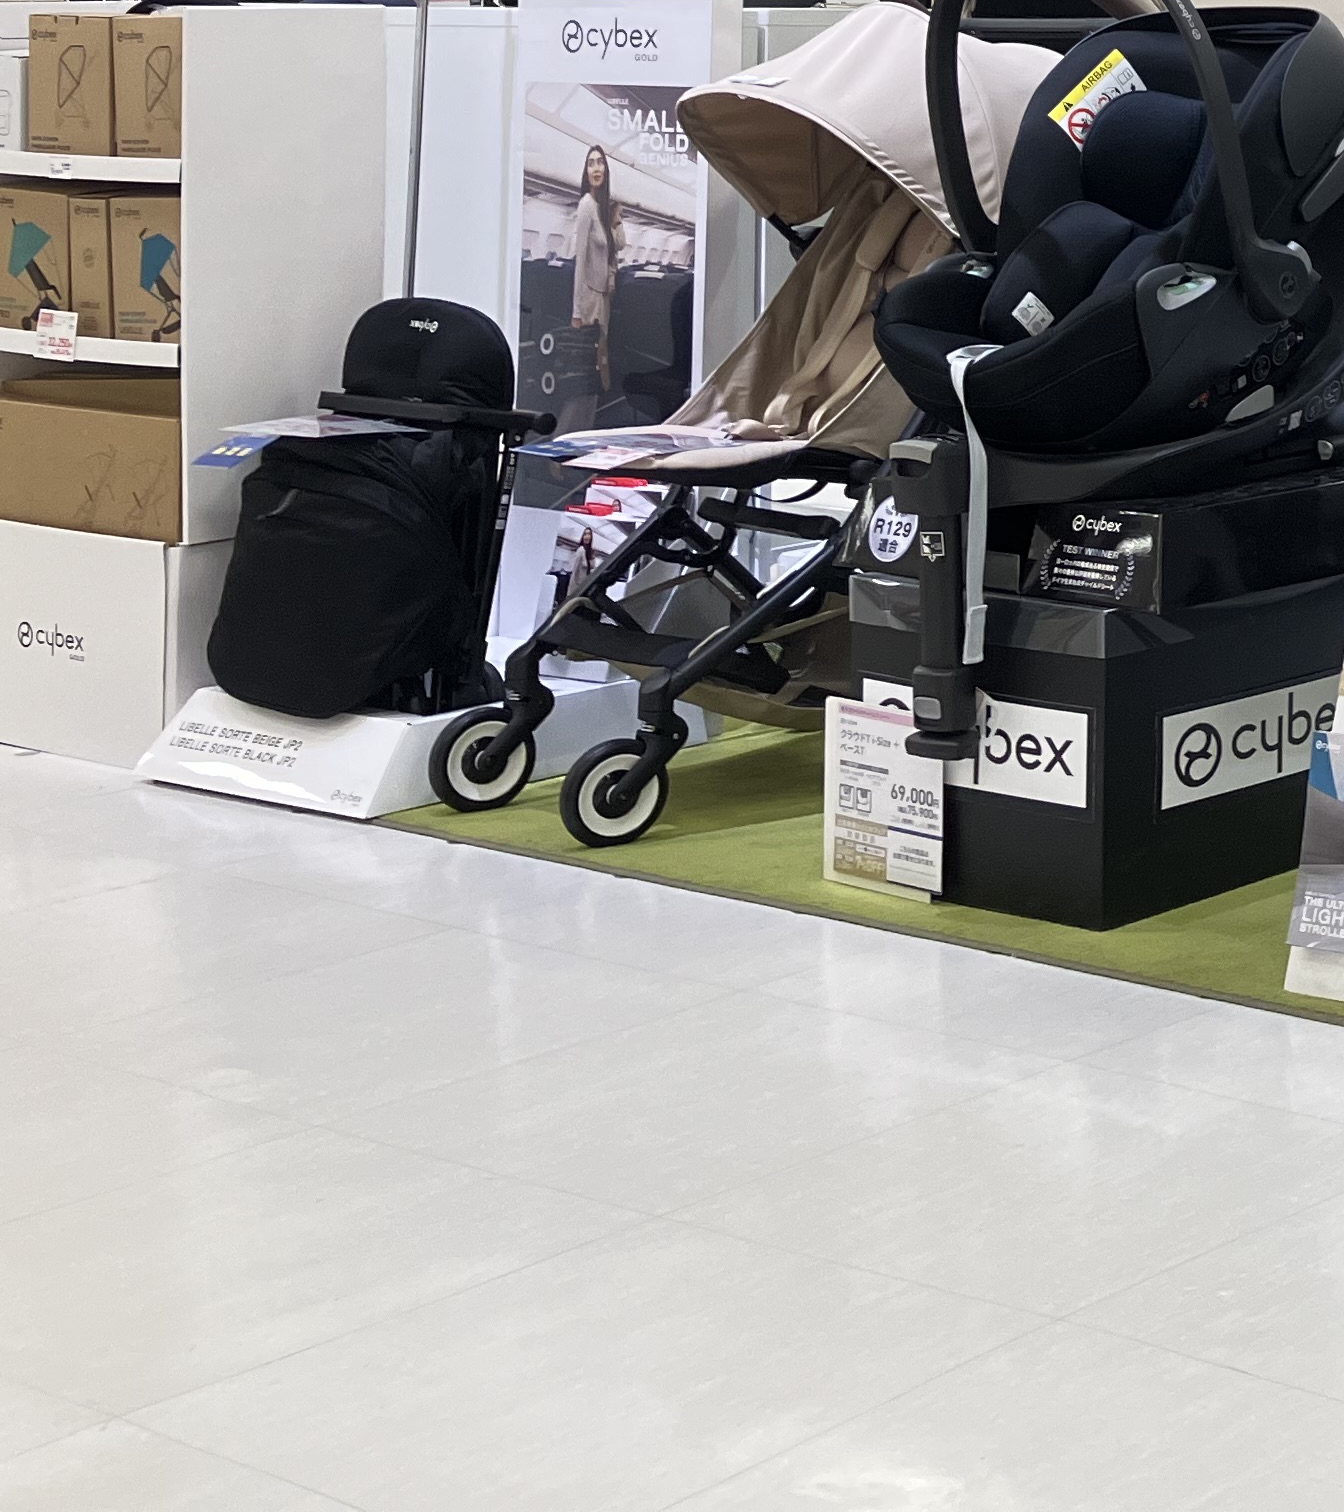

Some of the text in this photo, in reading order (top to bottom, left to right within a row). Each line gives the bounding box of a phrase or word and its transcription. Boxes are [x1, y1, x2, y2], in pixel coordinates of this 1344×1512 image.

[586, 18, 659, 59] cybex
[634, 53, 659, 62] GOLD
[1080, 60, 1113, 93] AIRBAG
[639, 133, 689, 152] FOLD
[874, 518, 912, 537] R129
[1086, 515, 1122, 536] cybex
[1063, 544, 1119, 559] TEST WINNER
[35, 623, 85, 656] cybex
[179, 721, 218, 737] LIBELLE
[220, 727, 251, 744] SORTE
[255, 734, 283, 748] BEIGE
[169, 736, 208, 753] LIBELLE
[209, 742, 242, 759] SORTE
[244, 748, 276, 763] BLACK
[891, 784, 939, 808] 69,000円
[1304, 896, 1325, 907] THE
